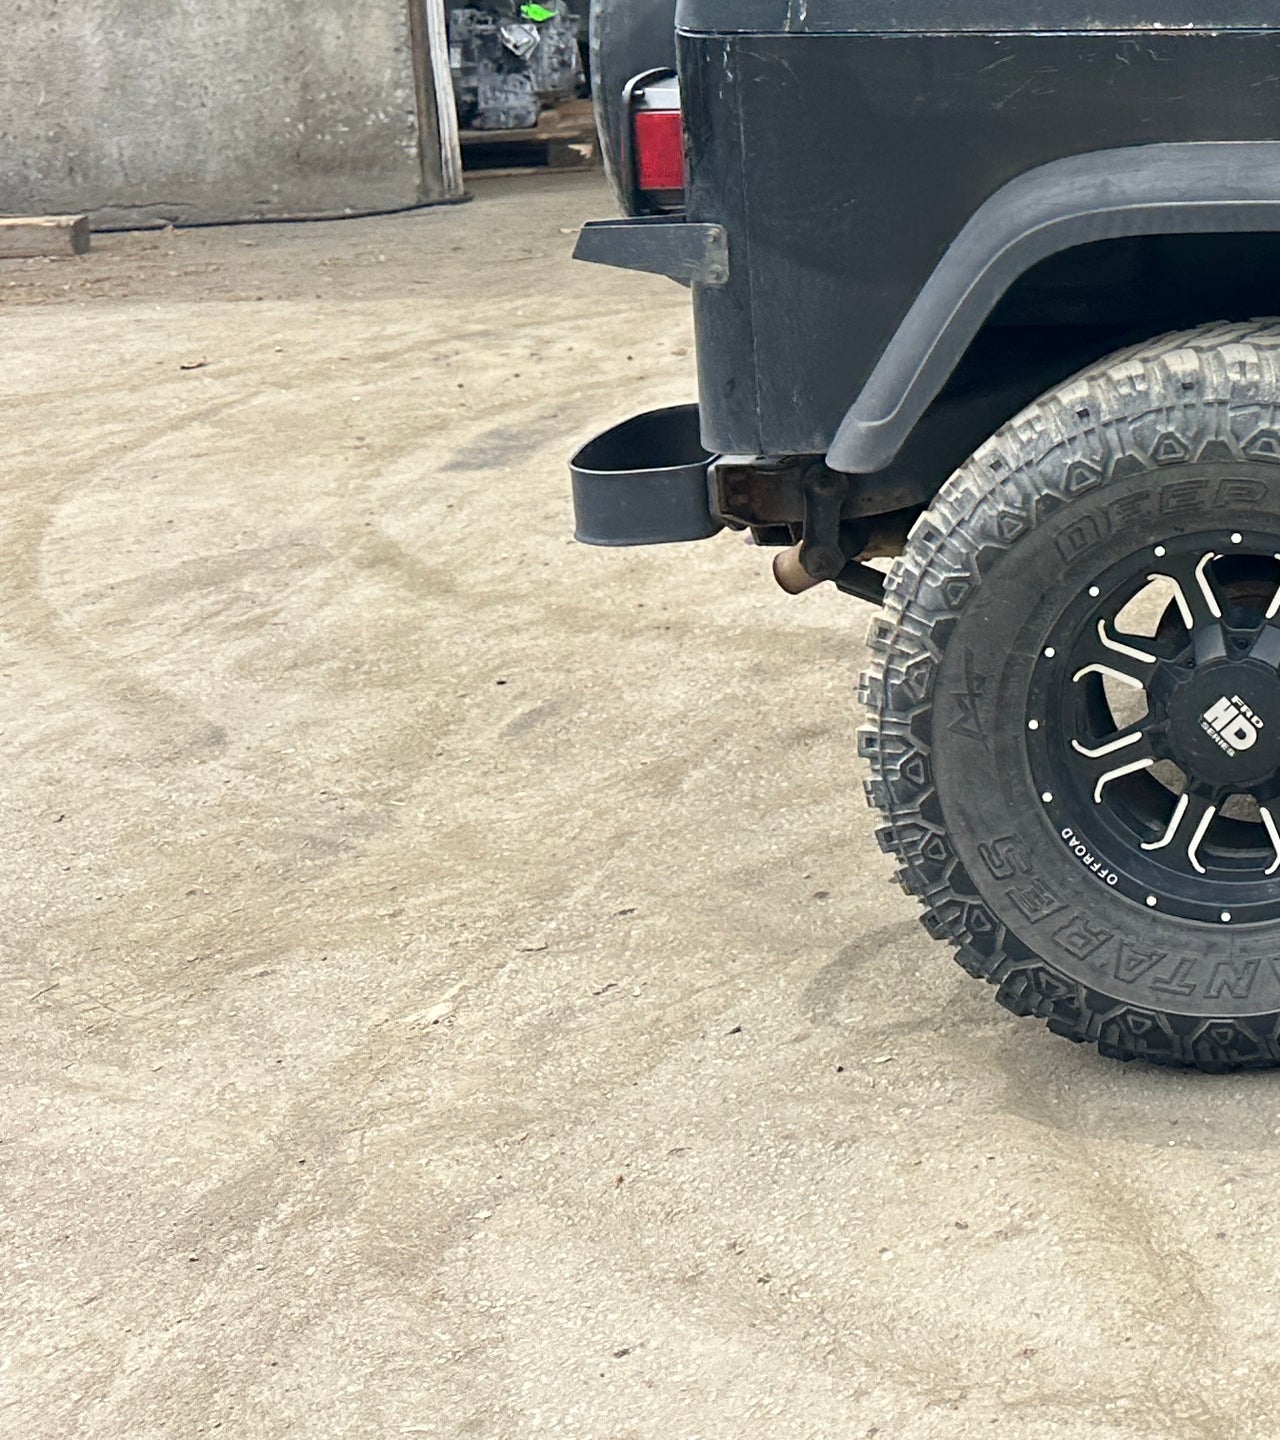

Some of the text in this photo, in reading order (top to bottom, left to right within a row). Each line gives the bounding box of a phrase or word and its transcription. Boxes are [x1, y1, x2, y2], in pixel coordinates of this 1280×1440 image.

[1053, 477, 1269, 561] DEEP
[1203, 696, 1257, 751] HD
[1061, 827, 1118, 885] OFFROAD
